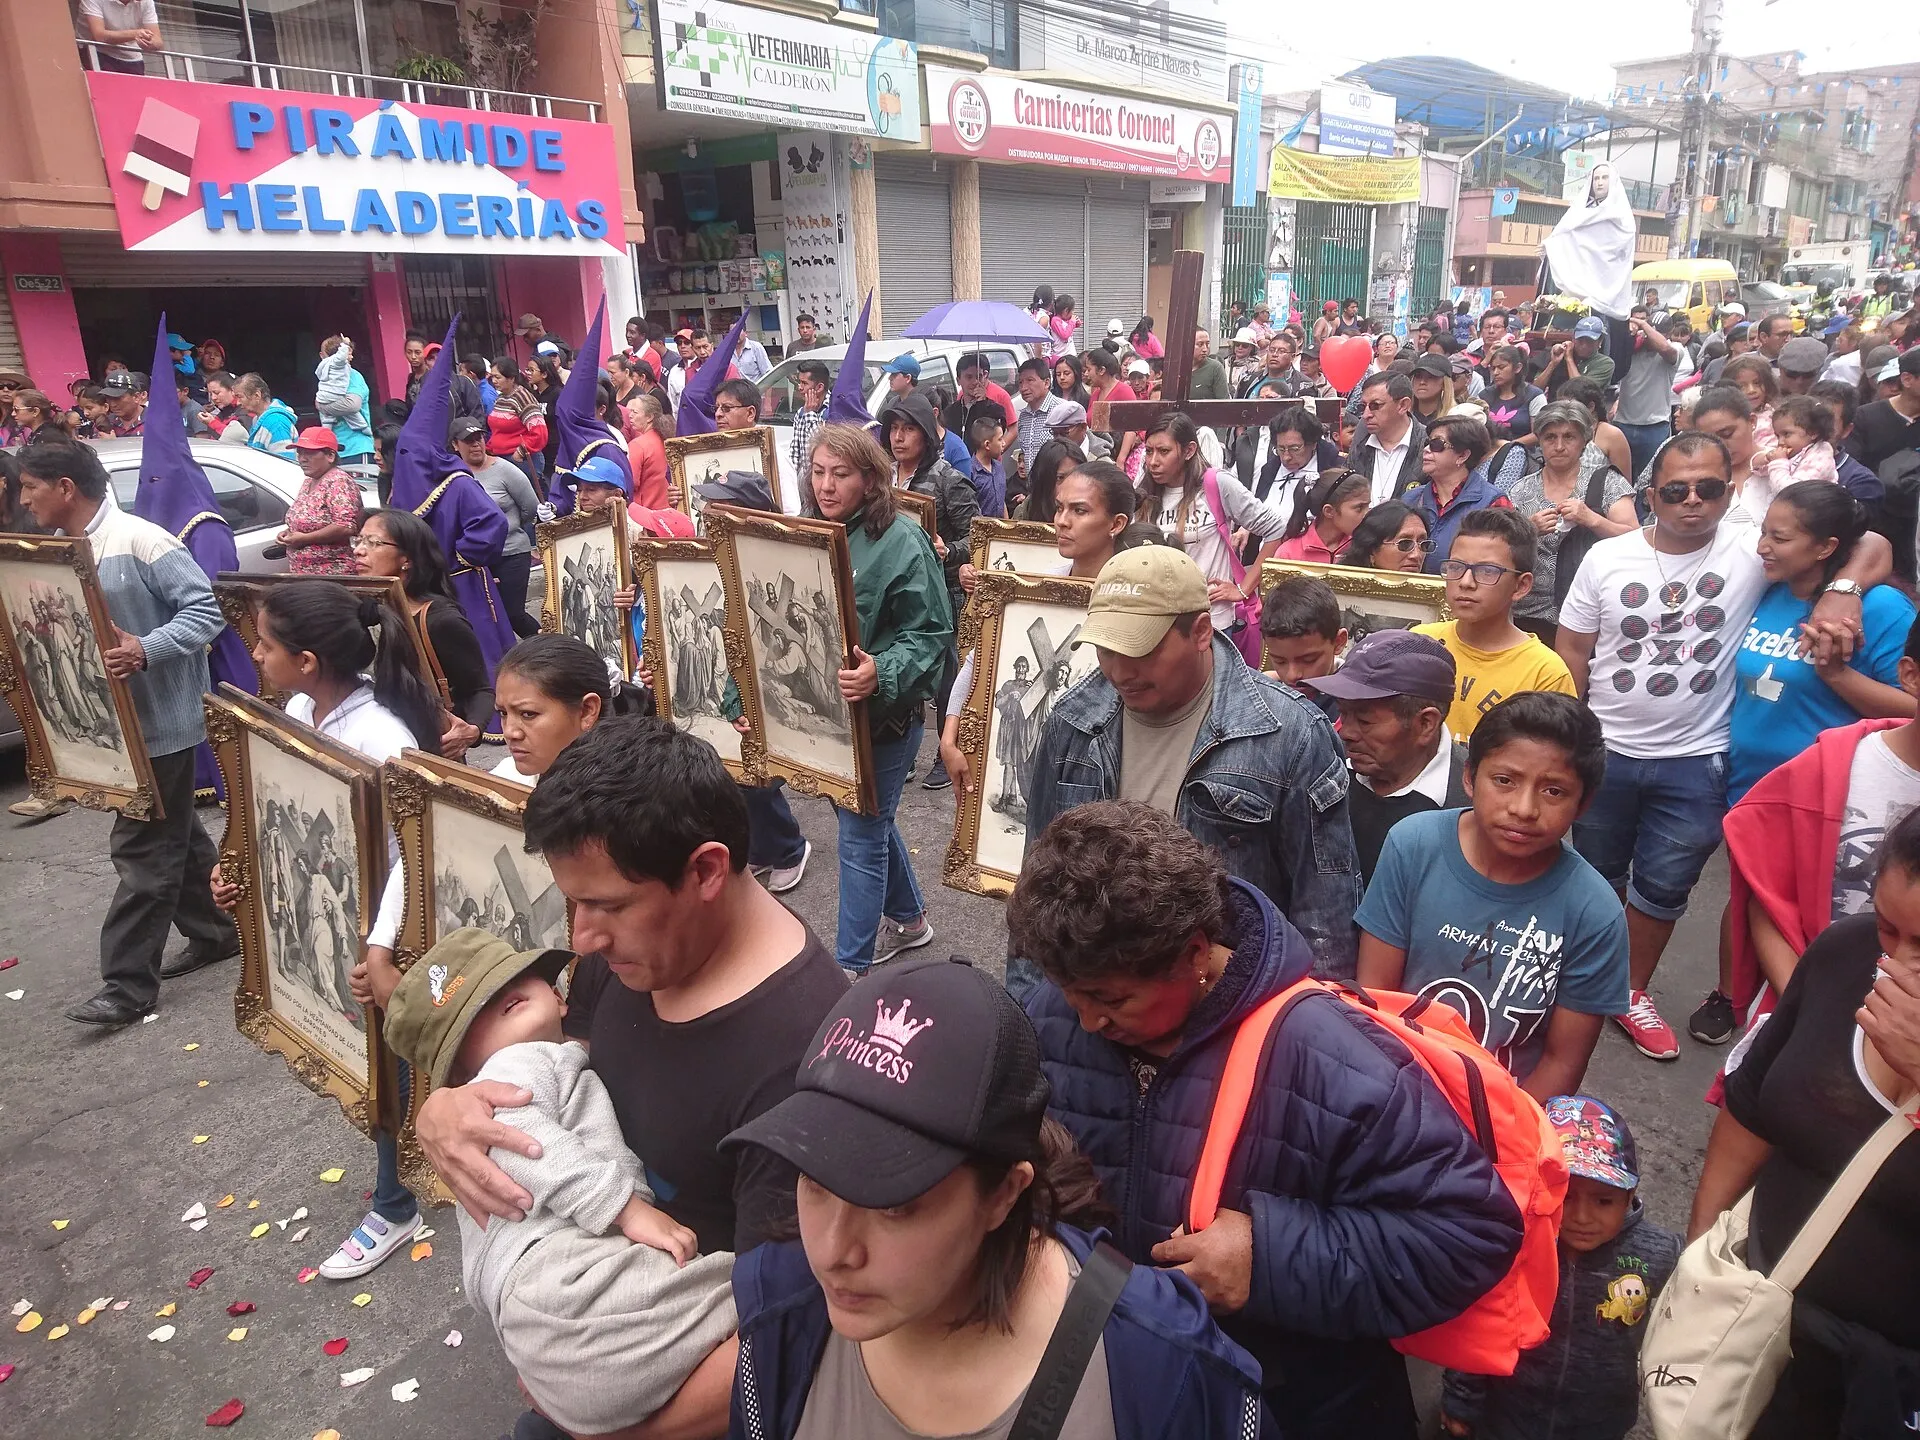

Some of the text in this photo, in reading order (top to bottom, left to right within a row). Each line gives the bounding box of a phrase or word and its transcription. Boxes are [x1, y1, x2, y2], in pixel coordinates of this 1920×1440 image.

[748, 32, 831, 70] VETERINARIA
[1077, 34, 1092, 55] Dr.
[1095, 38, 1127, 62] Marco
[1162, 53, 1191, 77] Navas
[1193, 60, 1202, 77] S.
[753, 66, 831, 93] CALDERÓN
[1014, 88, 1175, 145] Carnicerías Coronel
[1349, 93, 1371, 109] QUITO
[229, 100, 566, 172] PIRÁMIDE
[1008, 148, 1044, 160] DISTRIBUIDORA
[1044, 152, 1054, 161] POR
[199, 180, 609, 240] HELADERÍAS
[19, 278, 59, 289] Oe5-22
[808, 1018, 914, 1084] Princess
